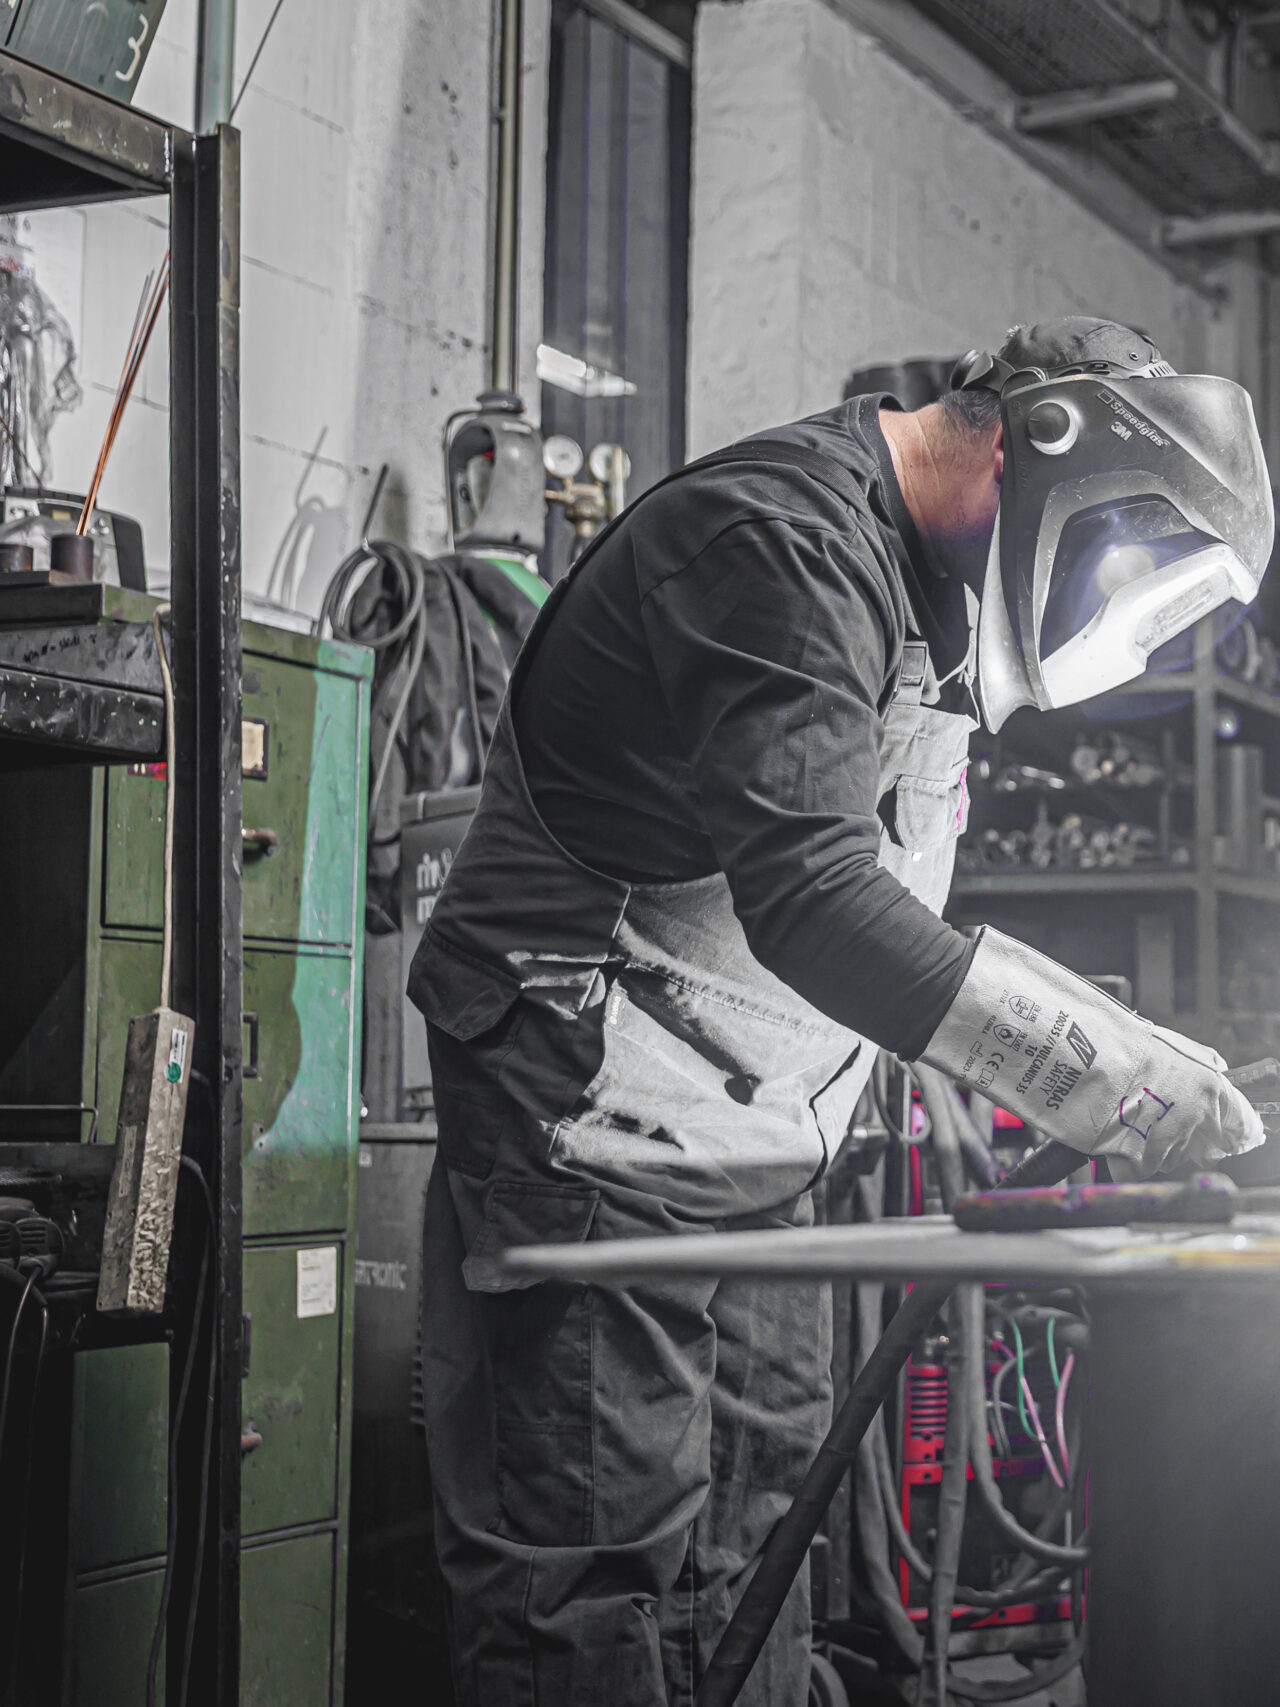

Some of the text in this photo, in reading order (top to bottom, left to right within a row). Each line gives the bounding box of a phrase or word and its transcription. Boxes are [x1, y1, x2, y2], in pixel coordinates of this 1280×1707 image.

[1110, 421, 1133, 441] 3M
[1050, 1010, 1069, 1037] 20035
[1024, 1045, 1037, 1056] 10
[1022, 1045, 1054, 1085] VULCANUS
[1030, 1060, 1068, 1095] SAFETY
[1016, 1082, 1029, 1095] 35
[1046, 1066, 1082, 1110] NITRAS
